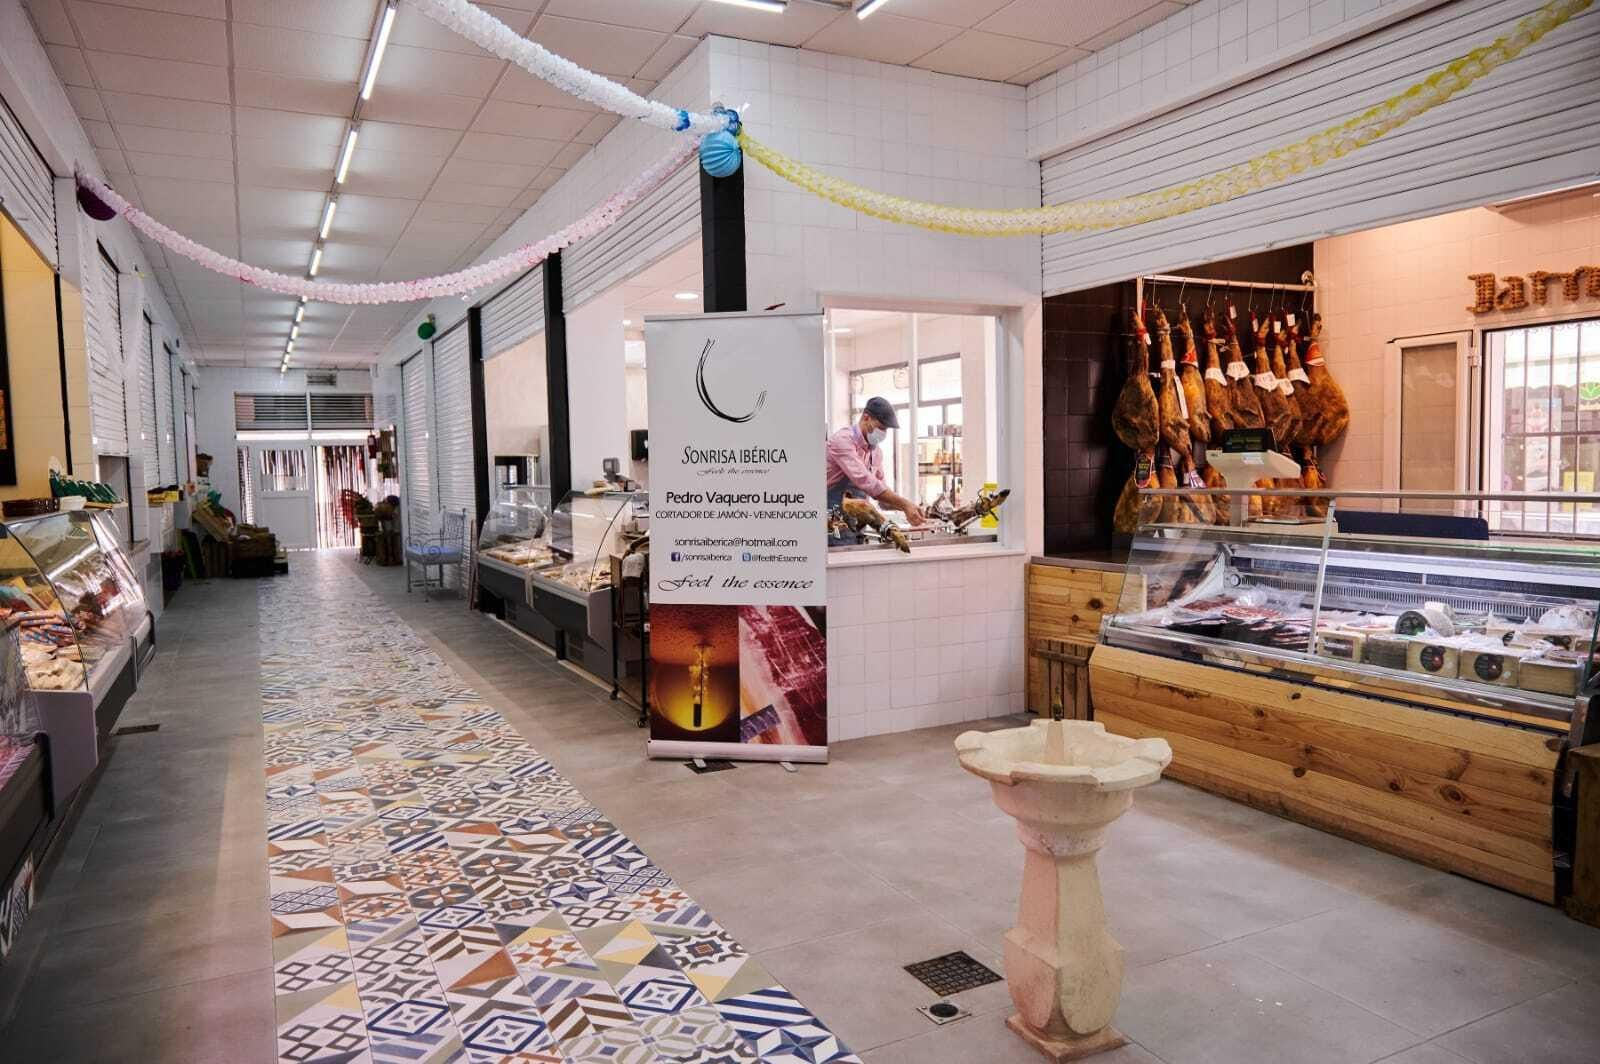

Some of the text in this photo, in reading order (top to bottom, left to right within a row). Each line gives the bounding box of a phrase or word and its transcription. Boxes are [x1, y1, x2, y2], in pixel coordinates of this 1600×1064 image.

[681, 446, 788, 464] SONRISA IBÉRICA
[666, 491, 805, 507] Pedro Vaquero Luque
[655, 510, 702, 519] CORTADOR
[703, 510, 717, 519] DE
[753, 510, 818, 519] VENENCIADOR
[674, 536, 798, 547] sonrisaiberica@hotmail.com
[721, 575, 749, 588] the
[753, 579, 814, 589] essence
